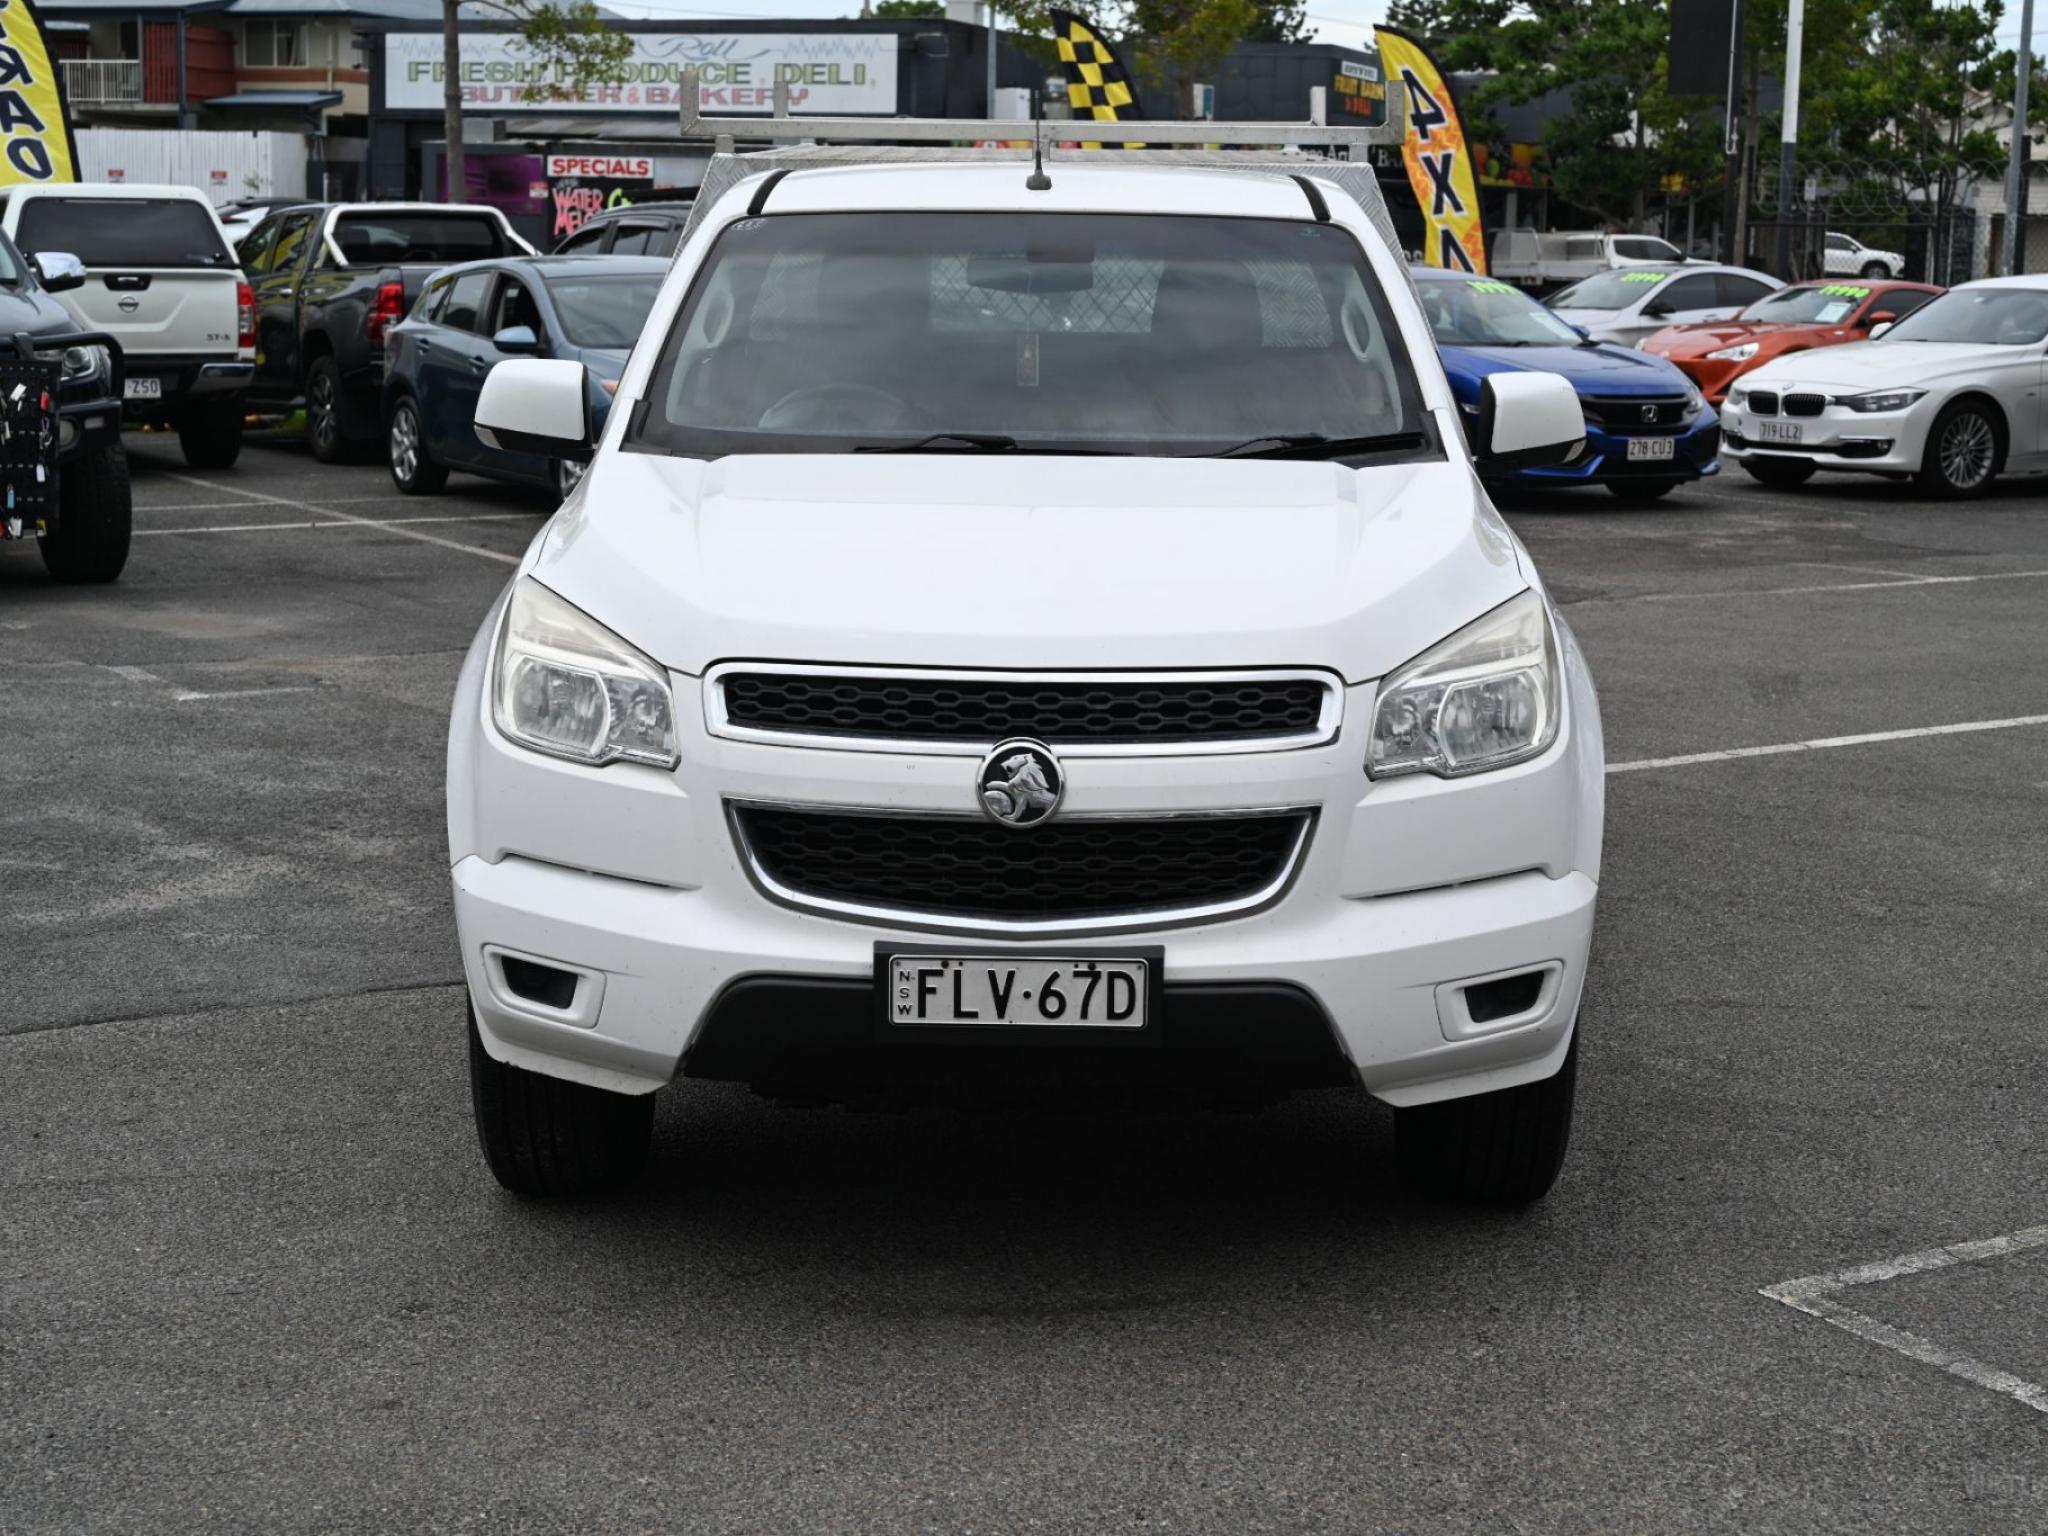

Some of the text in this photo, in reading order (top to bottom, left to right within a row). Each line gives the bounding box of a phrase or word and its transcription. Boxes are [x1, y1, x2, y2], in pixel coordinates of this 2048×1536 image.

[554, 61, 752, 85] PODUCE
[773, 63, 866, 85] DELI
[645, 87, 809, 106] BKERY
[552, 158, 650, 176] SPECIALS
[552, 187, 604, 214] WATER
